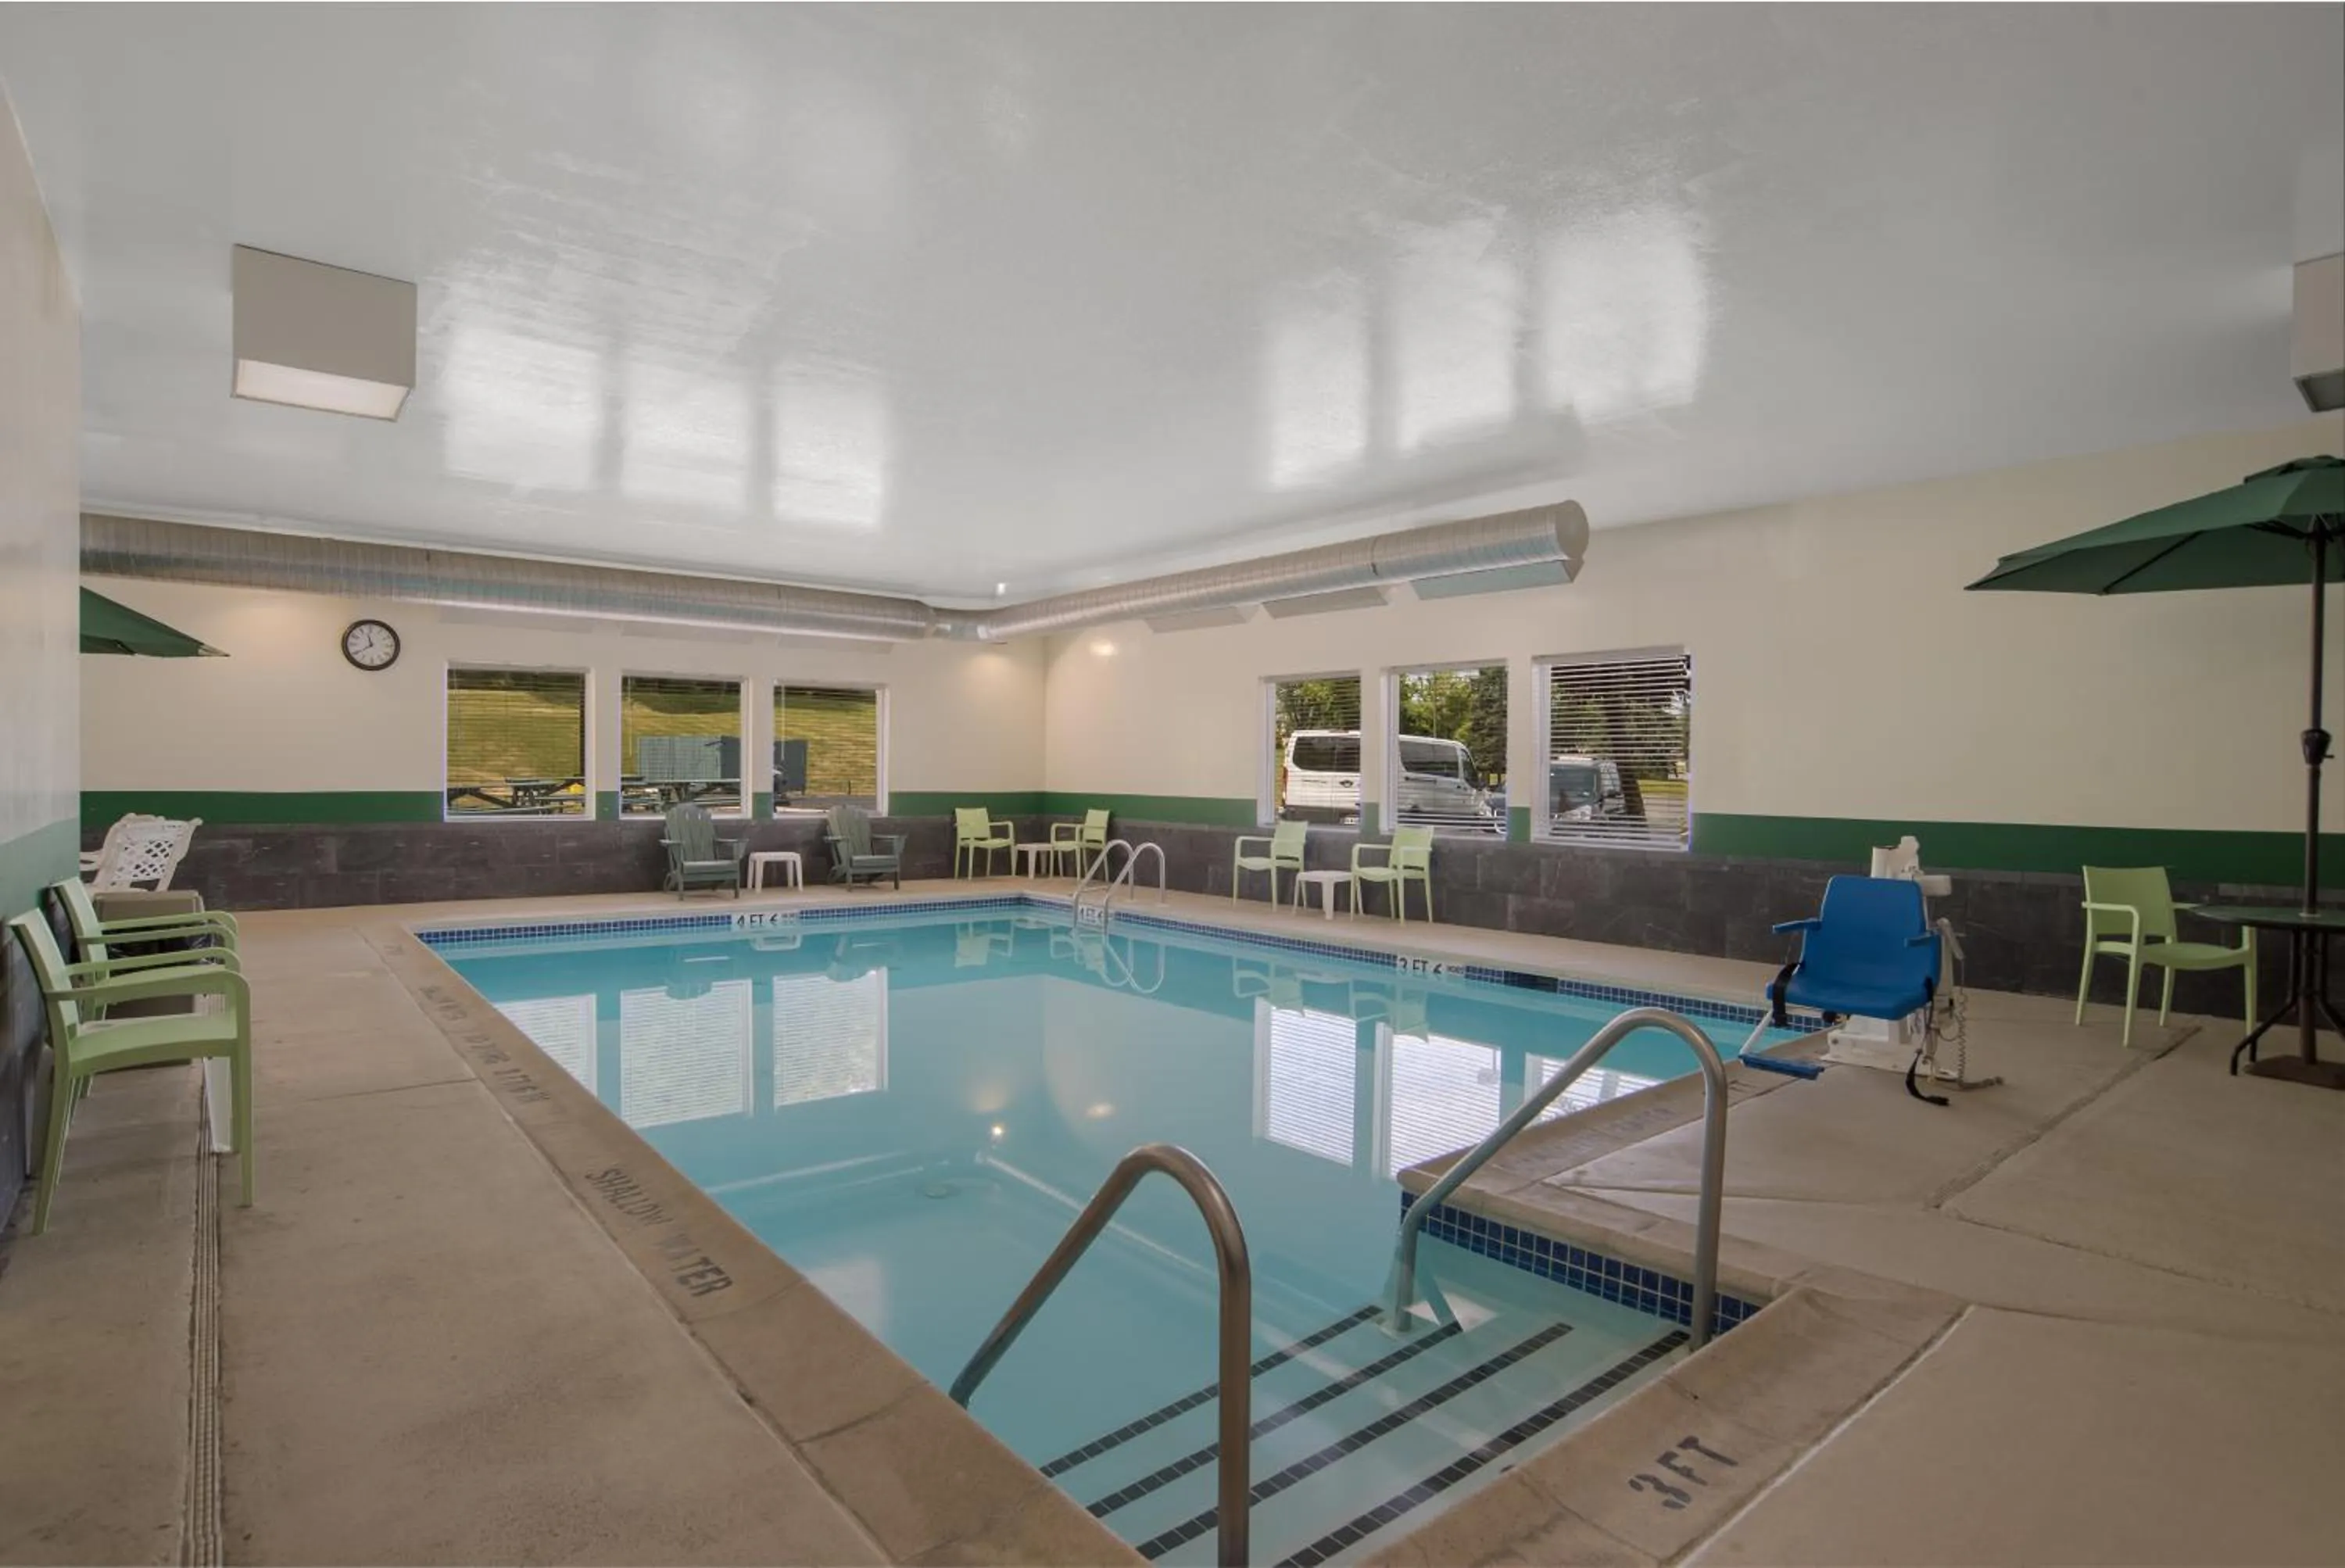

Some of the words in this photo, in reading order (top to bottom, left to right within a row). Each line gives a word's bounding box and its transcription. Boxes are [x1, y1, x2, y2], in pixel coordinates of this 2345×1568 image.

[750, 914, 764, 926] FT
[1412, 958, 1428, 973] FT
[585, 1168, 675, 1227] SHALLOW
